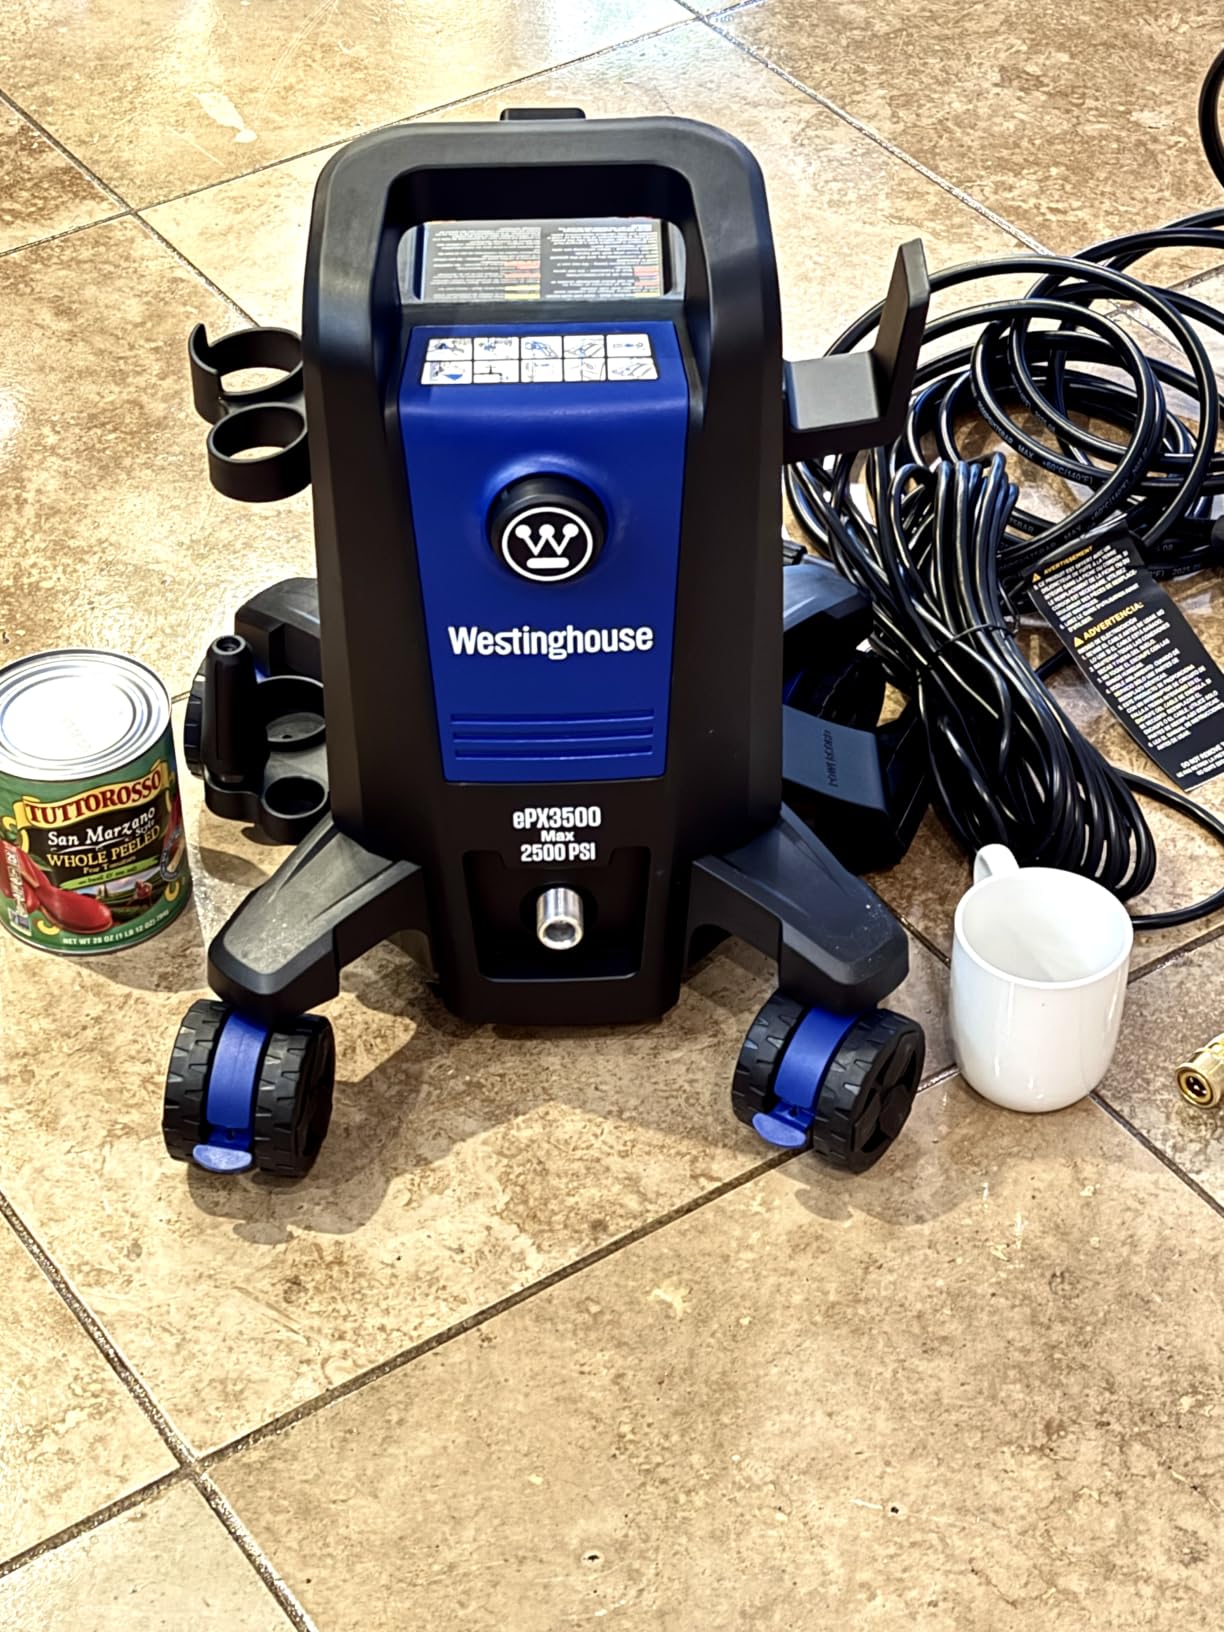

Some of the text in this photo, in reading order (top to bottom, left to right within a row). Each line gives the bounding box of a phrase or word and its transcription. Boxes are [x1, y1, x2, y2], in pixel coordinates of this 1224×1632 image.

[1018, 444, 1034, 458] MAX
[1043, 545, 1094, 575] AVERTISSEMENT
[1083, 602, 1144, 640] ADVERTENCIA:
[448, 625, 653, 660] Westinghouse
[25, 769, 162, 824] TUTTOROSSO
[48, 807, 155, 846] San Marzano
[512, 806, 602, 828] ePX3500
[46, 825, 160, 868] WHOLE PEELED
[520, 842, 596, 862] 2500 PSI
[541, 830, 574, 842] Max
